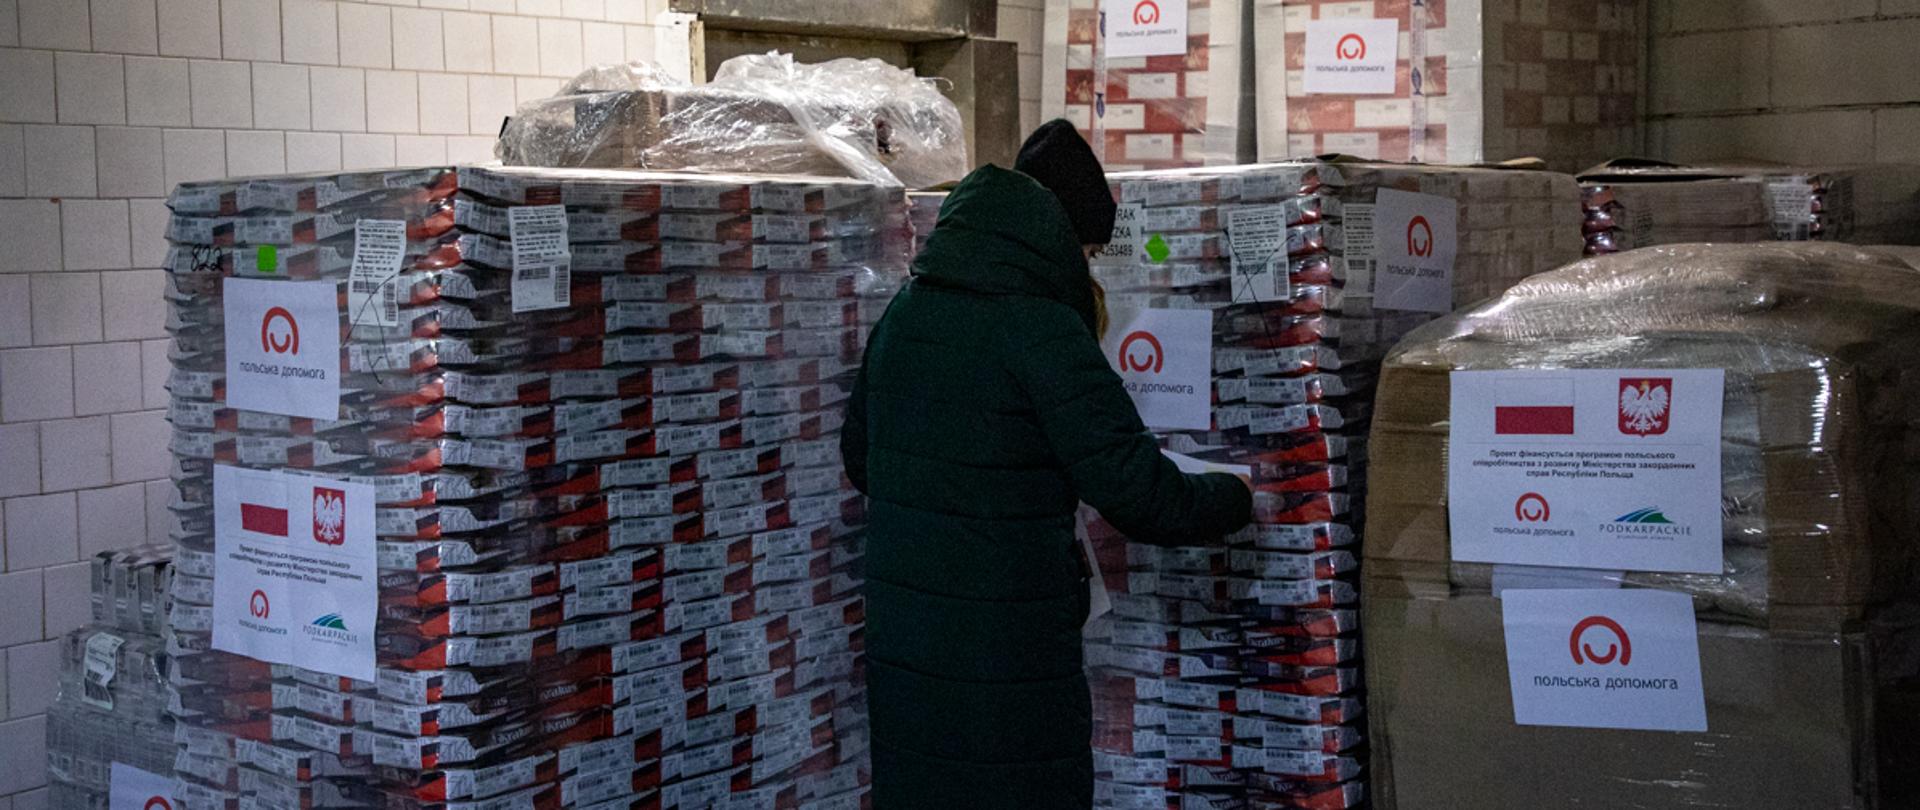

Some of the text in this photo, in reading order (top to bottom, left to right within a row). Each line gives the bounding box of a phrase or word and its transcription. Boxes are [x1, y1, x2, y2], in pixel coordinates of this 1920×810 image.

[240, 362, 325, 380] польська допомога
[1140, 383, 1194, 394] допомога
[1624, 452, 1676, 460] польського
[1493, 526, 1576, 538] польська допомога
[1599, 523, 1692, 536] PODKARPACKIE
[303, 625, 358, 643] PODKARPACKIE
[1534, 675, 1679, 691] польська допомога
